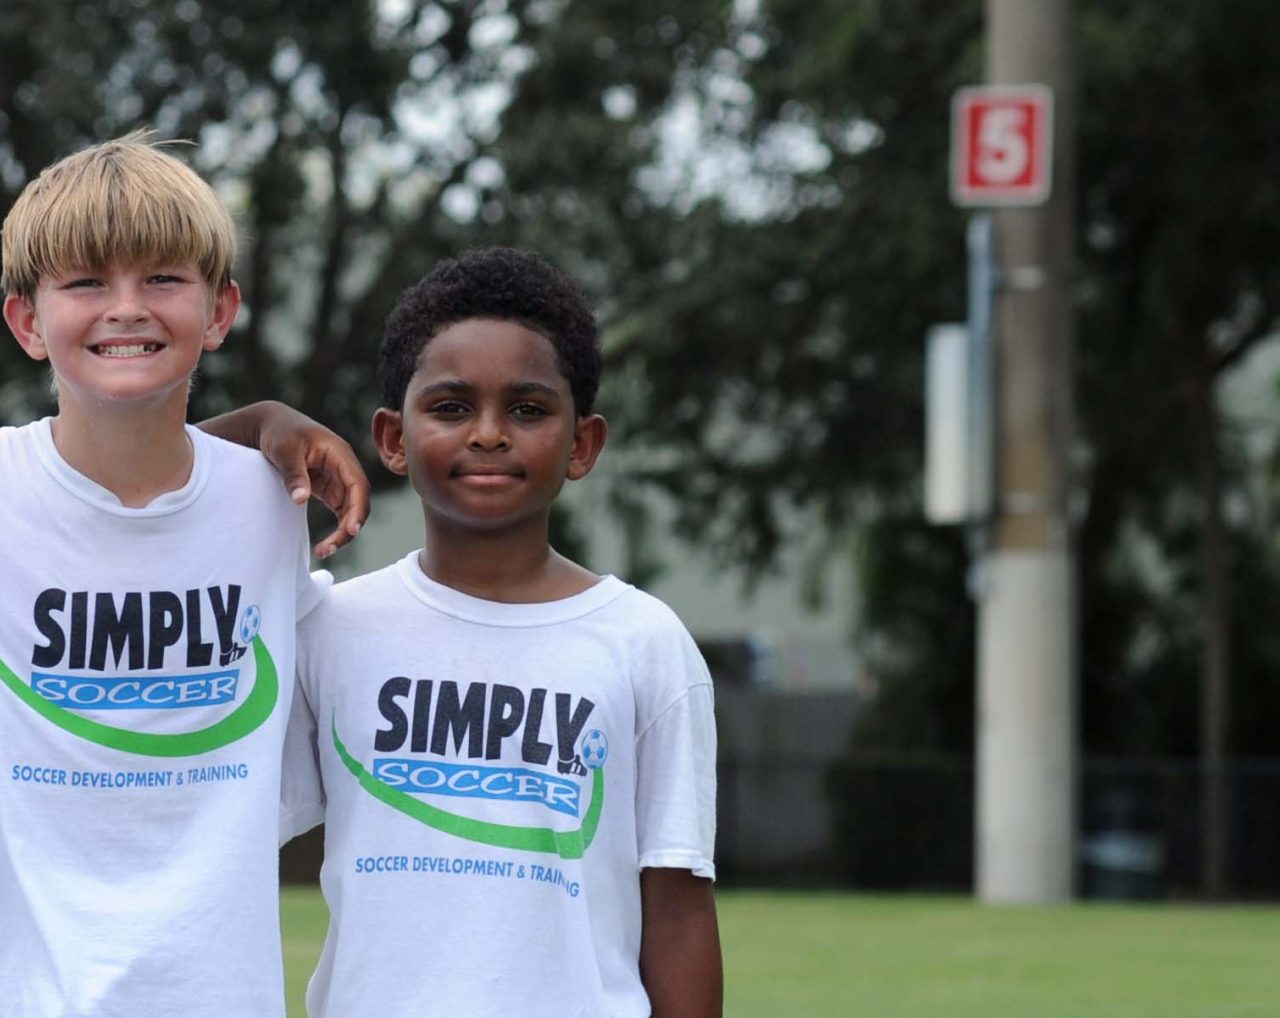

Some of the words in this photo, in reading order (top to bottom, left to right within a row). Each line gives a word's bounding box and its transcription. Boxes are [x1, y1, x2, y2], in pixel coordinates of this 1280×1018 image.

[975, 106, 1029, 183] 5
[31, 584, 242, 671] SIMPLY
[36, 675, 238, 704] SOCCER
[374, 676, 595, 770] SIMPLY
[12, 764, 67, 785] SOCCER
[72, 770, 173, 788] DEVELOPMENT
[176, 771, 184, 785] &
[187, 764, 249, 785] TRAINING
[378, 762, 578, 811] SOCCER
[355, 856, 408, 874] SOCCER
[413, 857, 514, 878] DEVELOPMENT
[517, 865, 525, 879] &
[530, 864, 580, 898] TRAING
